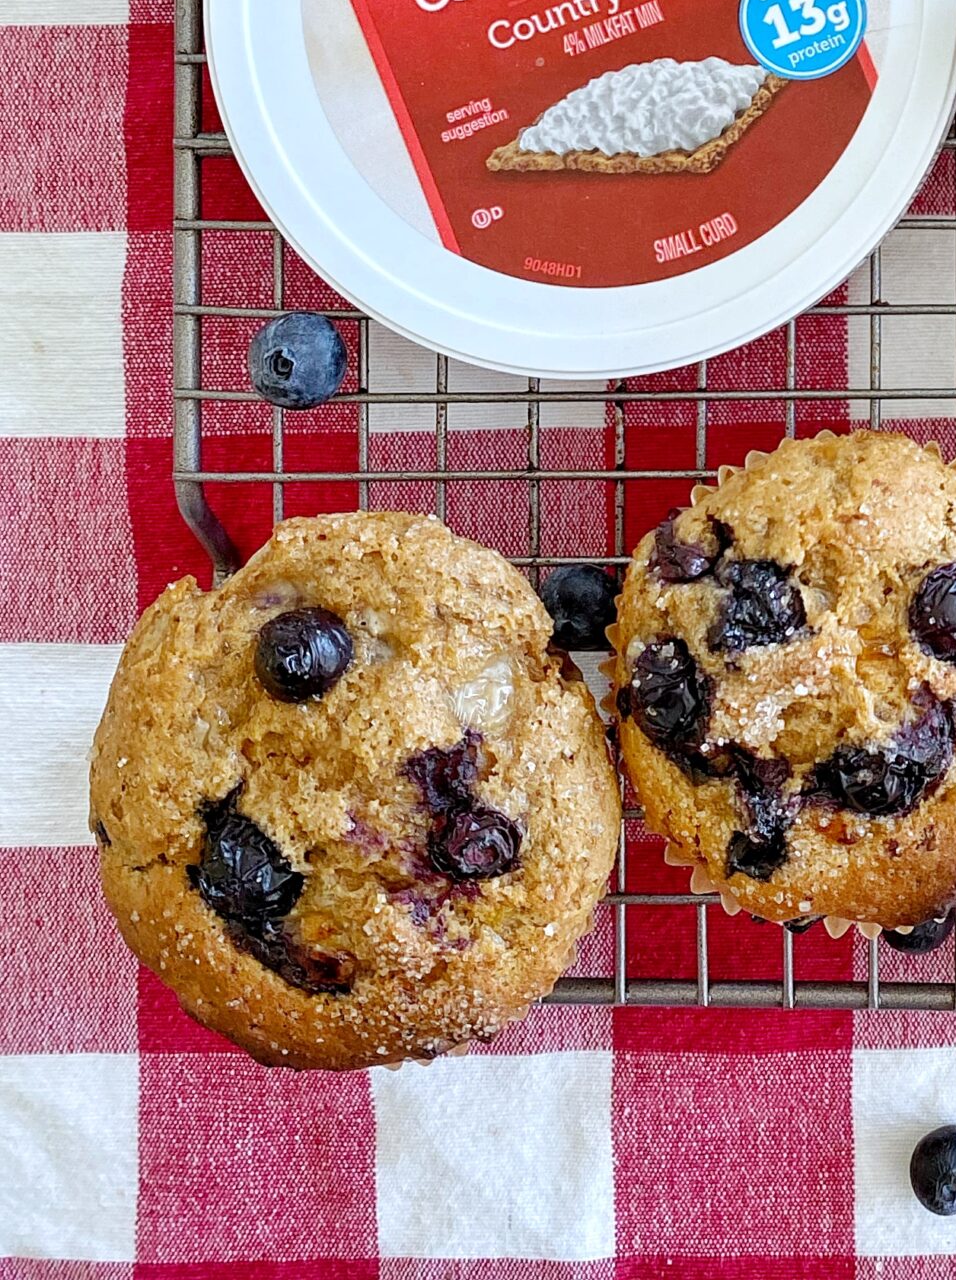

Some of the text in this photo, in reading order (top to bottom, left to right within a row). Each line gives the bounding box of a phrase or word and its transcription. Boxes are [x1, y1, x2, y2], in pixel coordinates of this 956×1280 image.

[562, 0, 664, 57] 4% MILKFAT MIN
[787, 34, 846, 68] protein
[441, 108, 508, 143] suggestion
[446, 97, 492, 124] serving
[653, 211, 739, 264] SMALL CURD
[523, 256, 582, 279] 9048HD1
